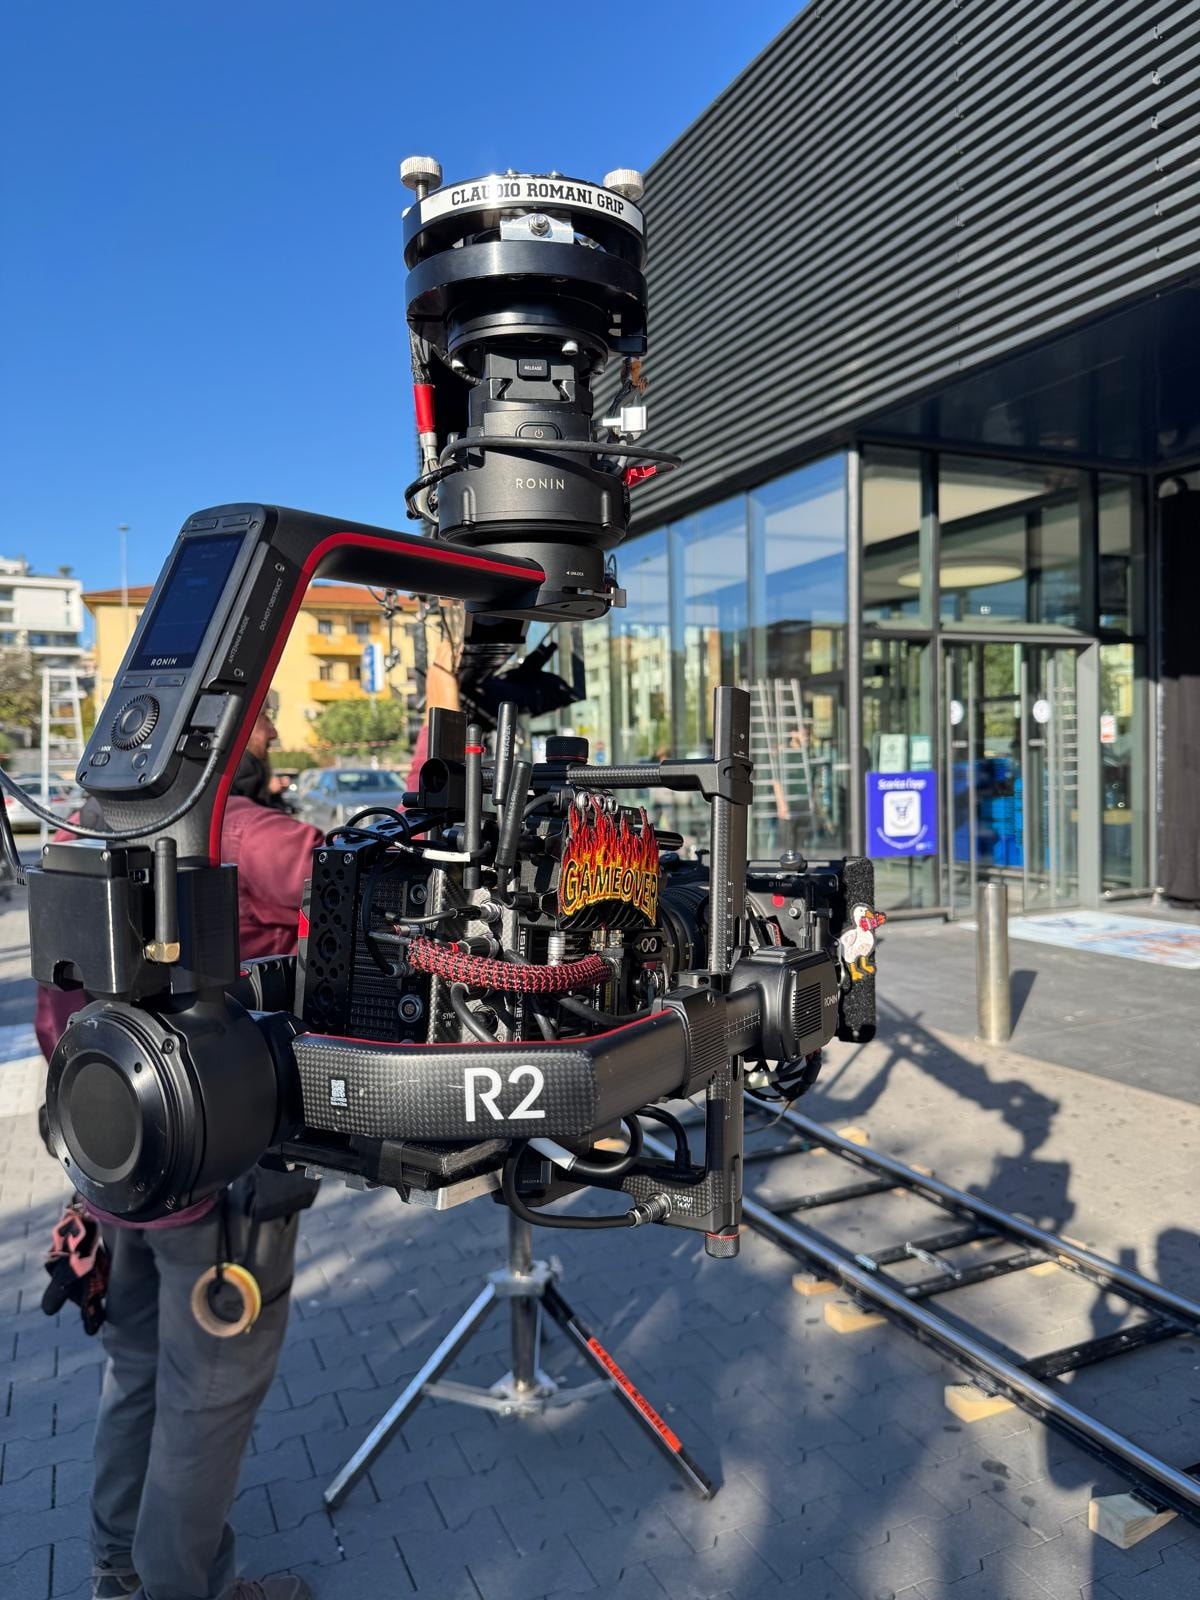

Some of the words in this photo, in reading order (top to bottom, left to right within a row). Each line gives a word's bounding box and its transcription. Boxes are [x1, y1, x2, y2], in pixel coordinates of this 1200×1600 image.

[526, 182, 592, 204] ROMANI
[596, 193, 625, 215] GRIP
[515, 477, 565, 490] RONIN
[150, 656, 178, 667] RONIN
[504, 724, 512, 761] TERADEK
[442, 1011, 456, 1020] SYNC
[464, 1065, 546, 1122] R2
[673, 1193, 693, 1204] DC-OUT
